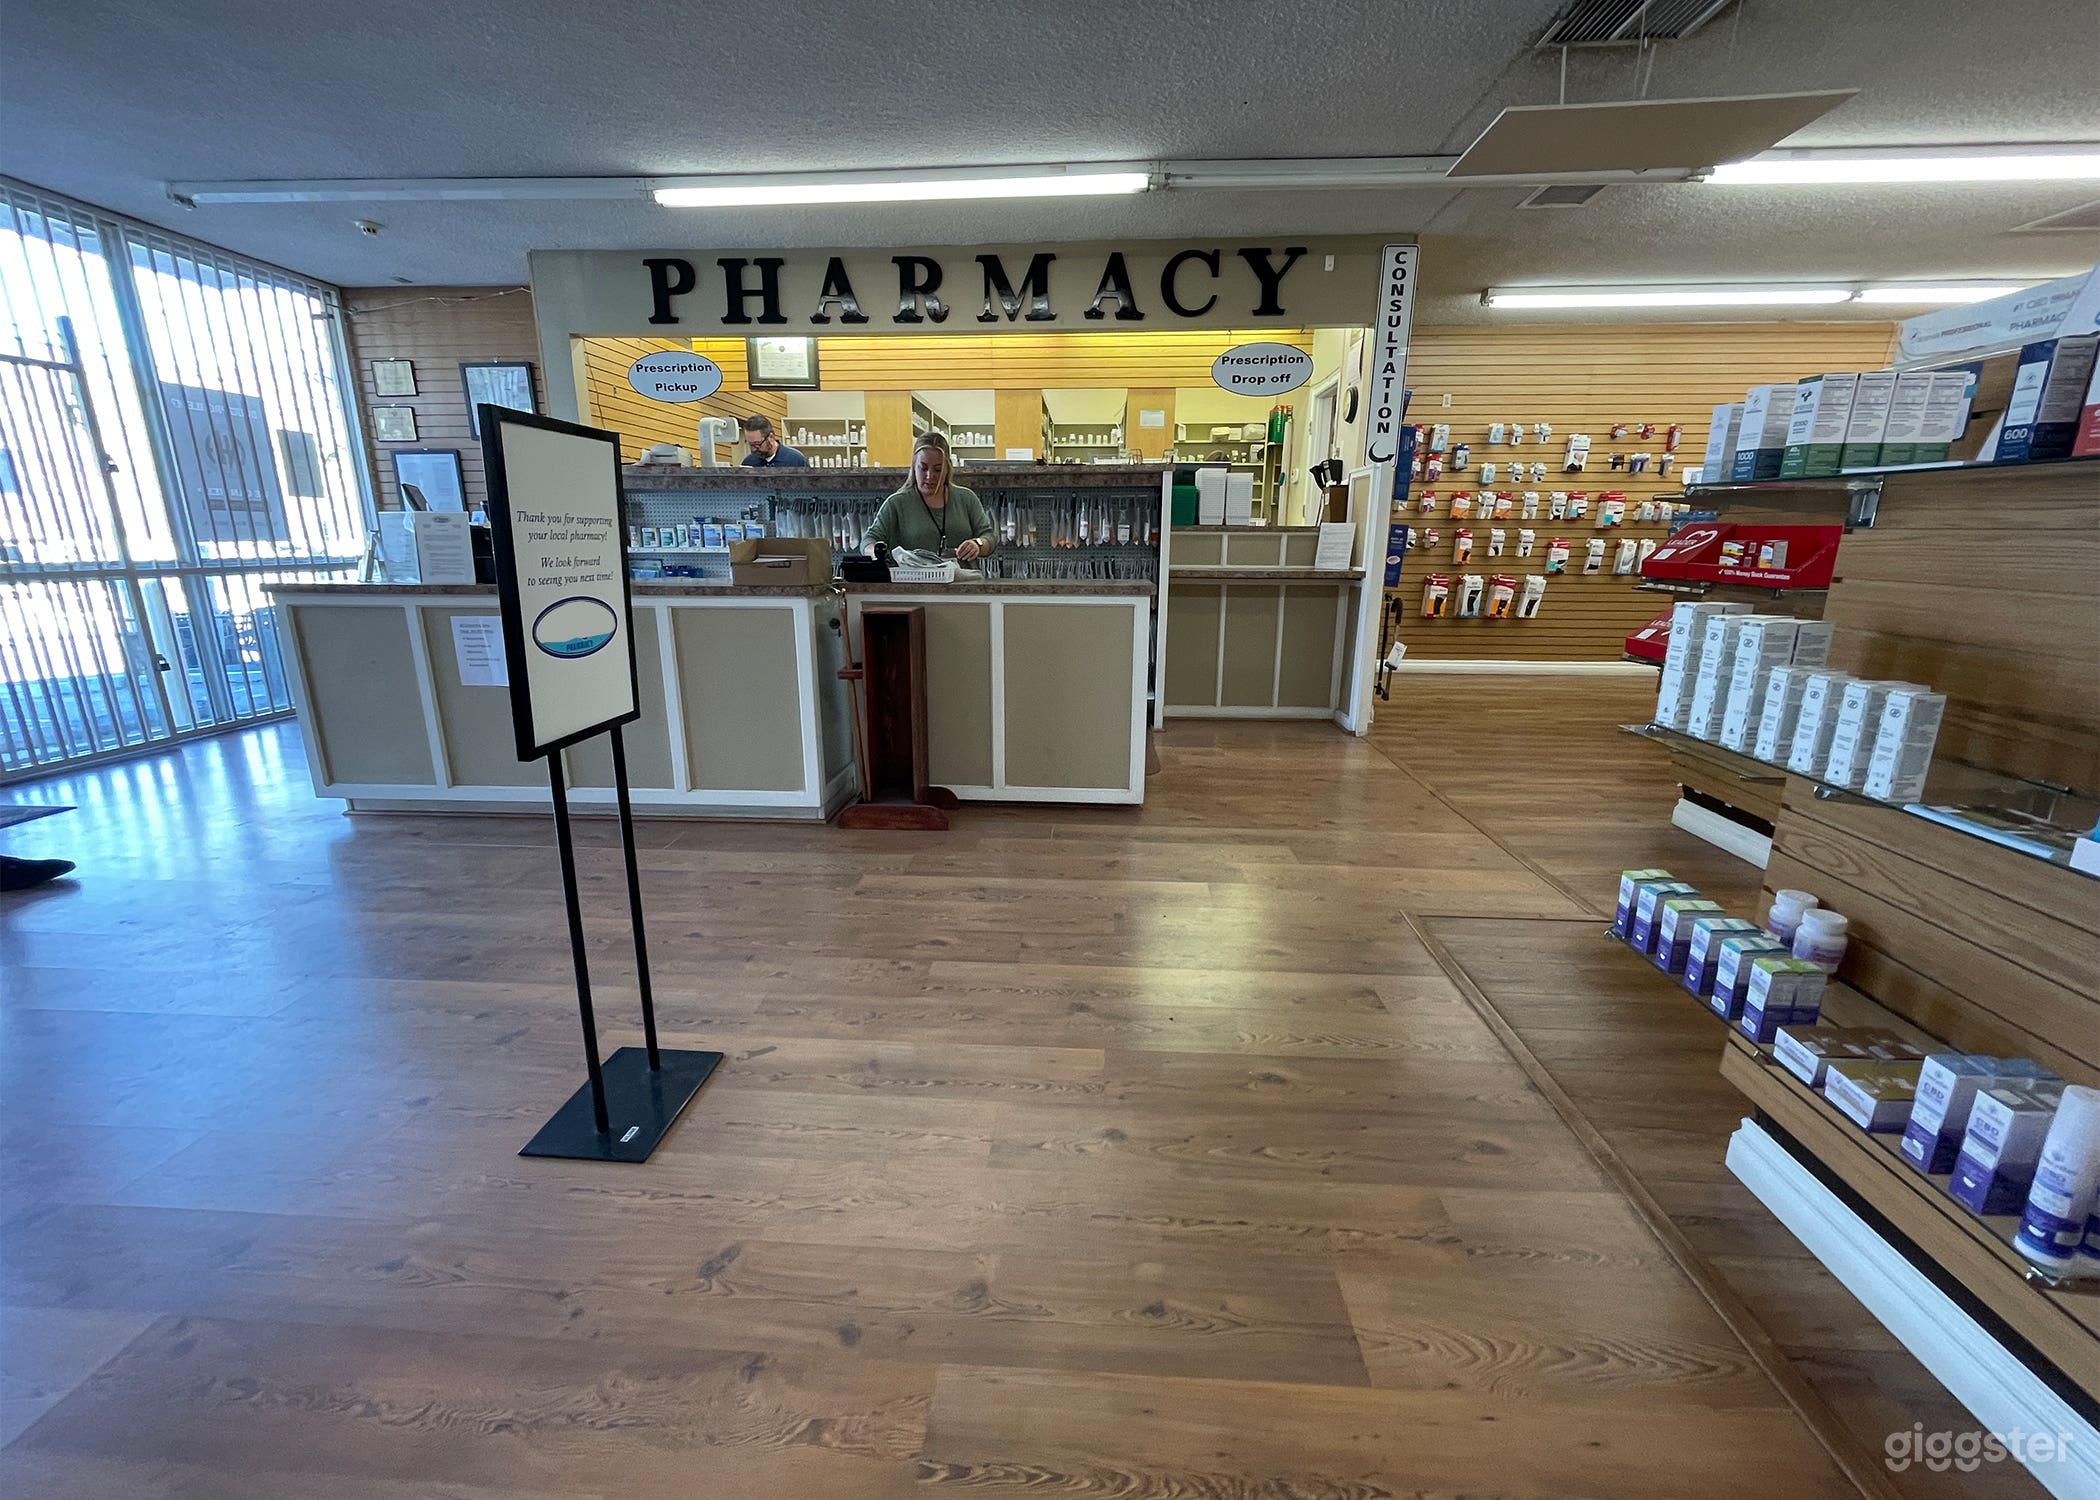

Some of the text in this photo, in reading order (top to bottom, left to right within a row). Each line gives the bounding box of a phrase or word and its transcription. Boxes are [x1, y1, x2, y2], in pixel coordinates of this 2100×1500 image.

[642, 247, 1308, 324] PHARMACY
[2008, 311, 2069, 332] PHARMAC
[1377, 251, 1408, 434] CONSULTATION
[1221, 354, 1304, 367] Prescription
[635, 362, 713, 375] Prescription
[1232, 373, 1291, 386] Drop off
[655, 382, 698, 393] Pickup
[2004, 428, 2028, 440] 600
[1737, 451, 1754, 461] 1000
[516, 510, 613, 528] Thank you for supporting
[528, 529, 608, 543] your local pharmacy!
[540, 555, 601, 569] We look forward
[527, 577, 536, 586] to
[538, 576, 563, 587] seeing
[564, 575, 578, 586] you
[579, 574, 595, 582] next
[1923, 1081, 1945, 1100] CBD
[1975, 1116, 1999, 1136] CBD
